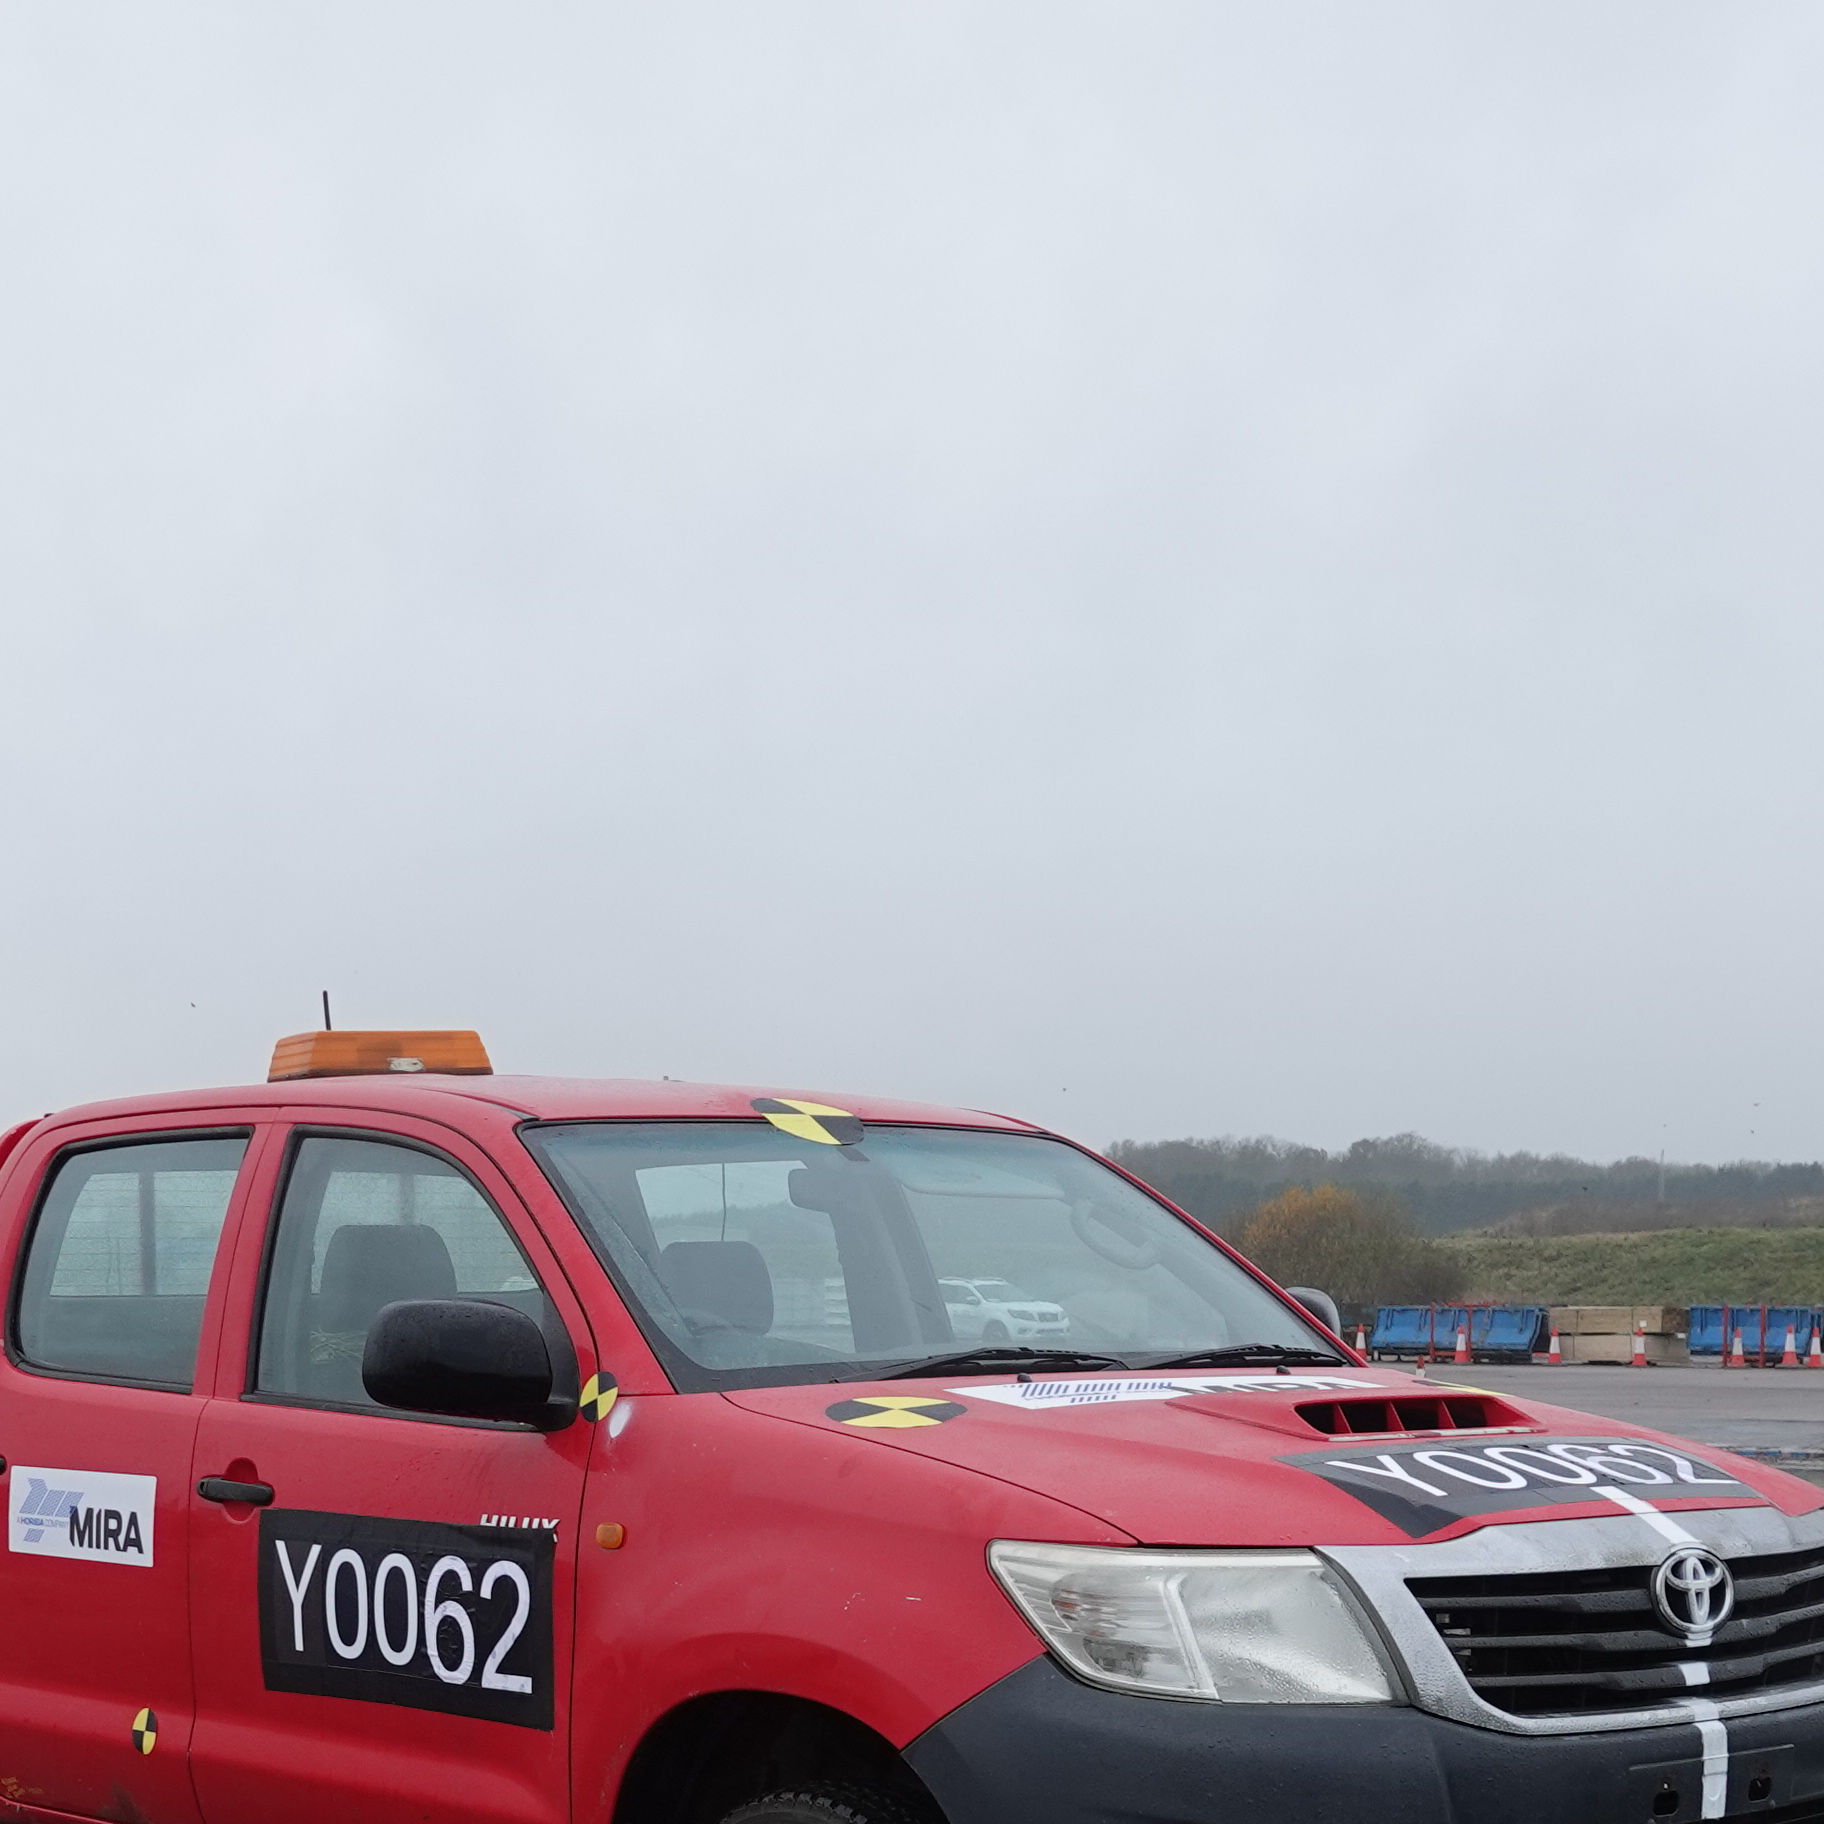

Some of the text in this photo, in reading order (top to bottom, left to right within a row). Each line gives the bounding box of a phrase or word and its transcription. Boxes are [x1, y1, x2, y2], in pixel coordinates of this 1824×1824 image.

[1324, 1443, 1742, 1497] Y0062
[69, 1505, 144, 1554] MIRA
[275, 1539, 532, 1694] Y0062
